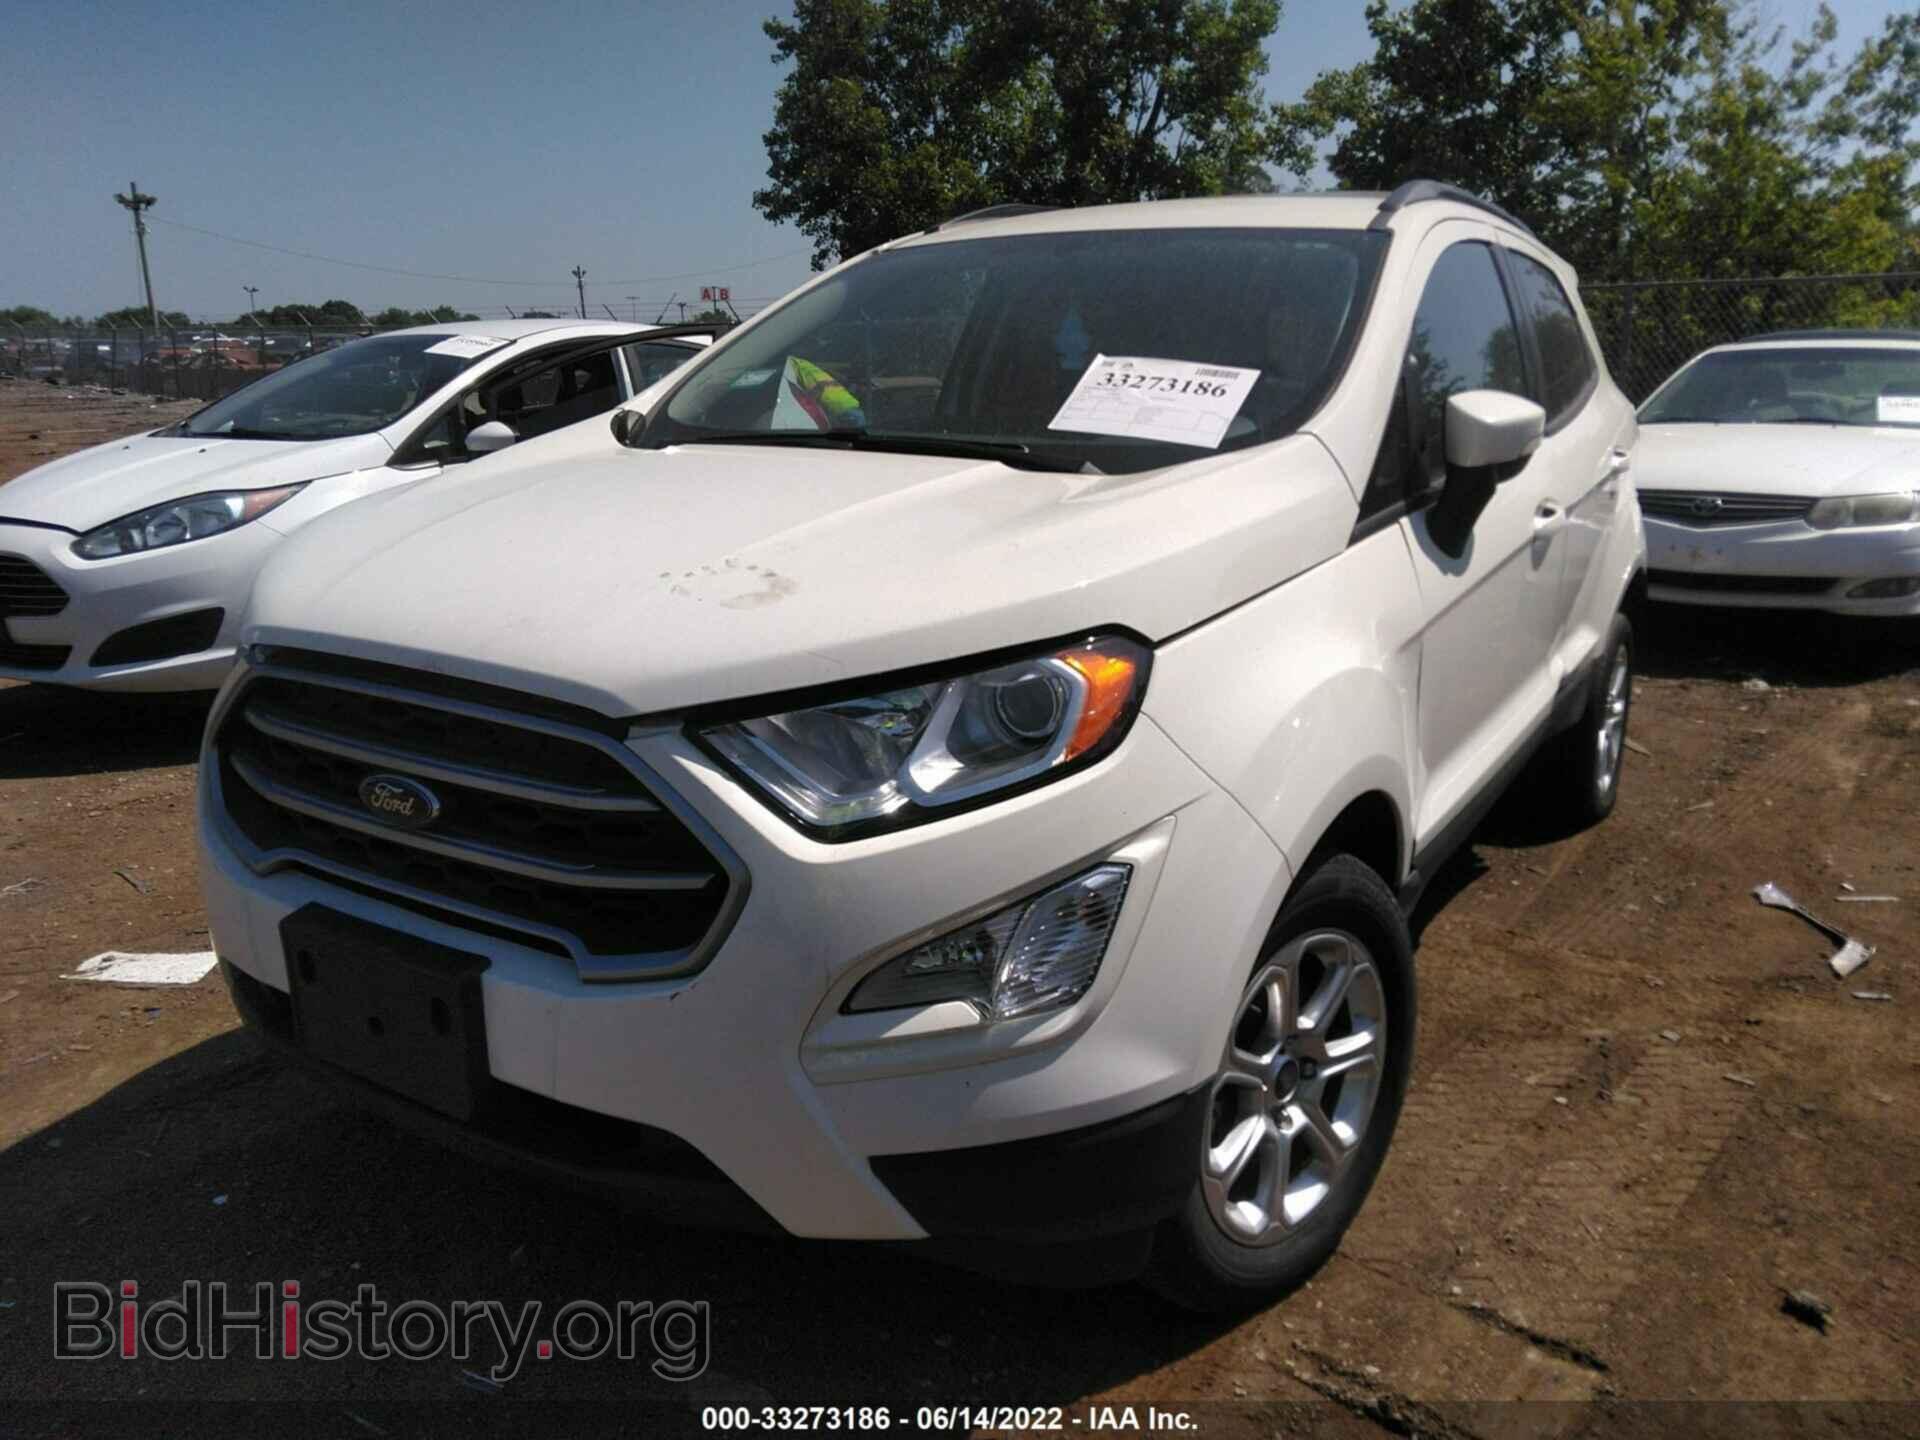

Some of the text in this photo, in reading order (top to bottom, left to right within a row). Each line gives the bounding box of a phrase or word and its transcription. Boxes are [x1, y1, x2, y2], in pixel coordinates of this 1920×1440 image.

[702, 288, 729, 301] A B
[1097, 371, 1227, 399] 33273186
[370, 782, 416, 816] Ford
